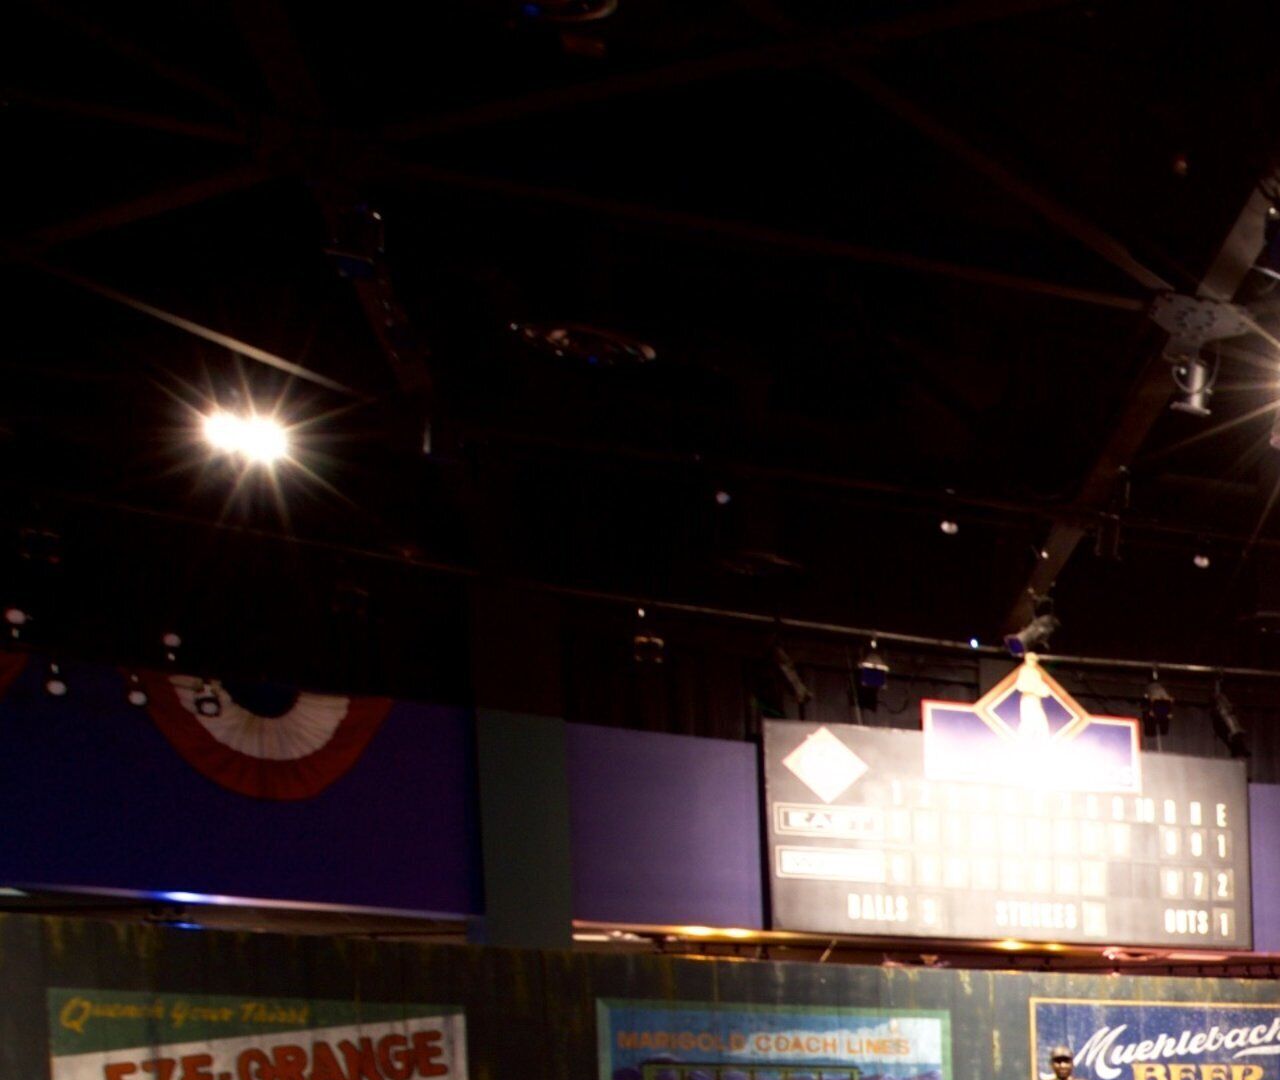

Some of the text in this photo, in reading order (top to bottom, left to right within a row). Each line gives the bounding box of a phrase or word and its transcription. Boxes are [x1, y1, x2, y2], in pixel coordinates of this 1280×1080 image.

[847, 893, 909, 922] BALLS
[1165, 908, 1208, 934] OUTS
[755, 1032, 837, 1055] COACH
[846, 1035, 910, 1057] LINES
